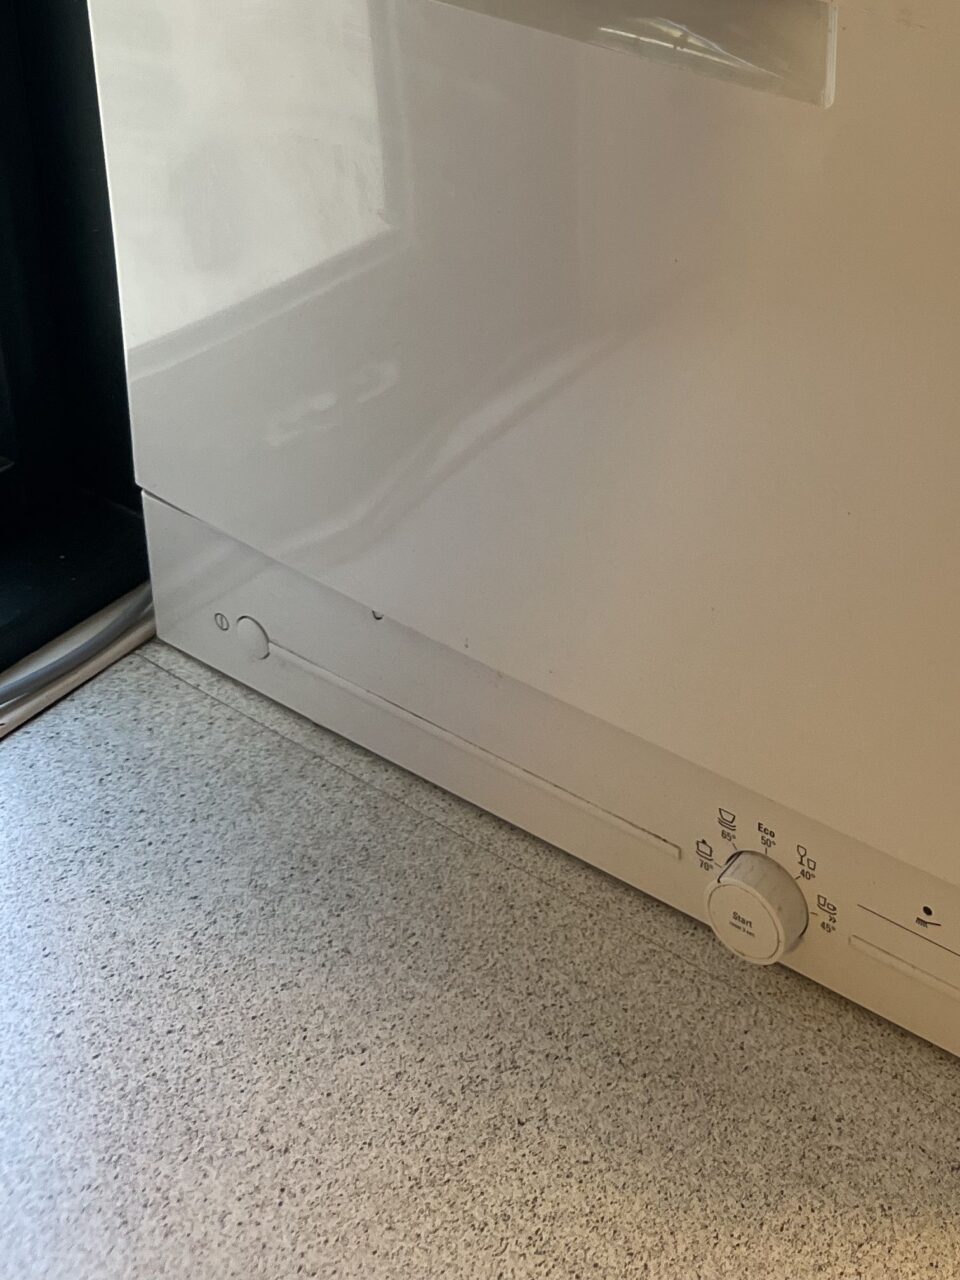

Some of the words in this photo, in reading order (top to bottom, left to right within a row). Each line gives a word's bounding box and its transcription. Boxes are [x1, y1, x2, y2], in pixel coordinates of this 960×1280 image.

[757, 822, 776, 838] Eco
[760, 835, 777, 848] 50°
[732, 911, 753, 928] Start
